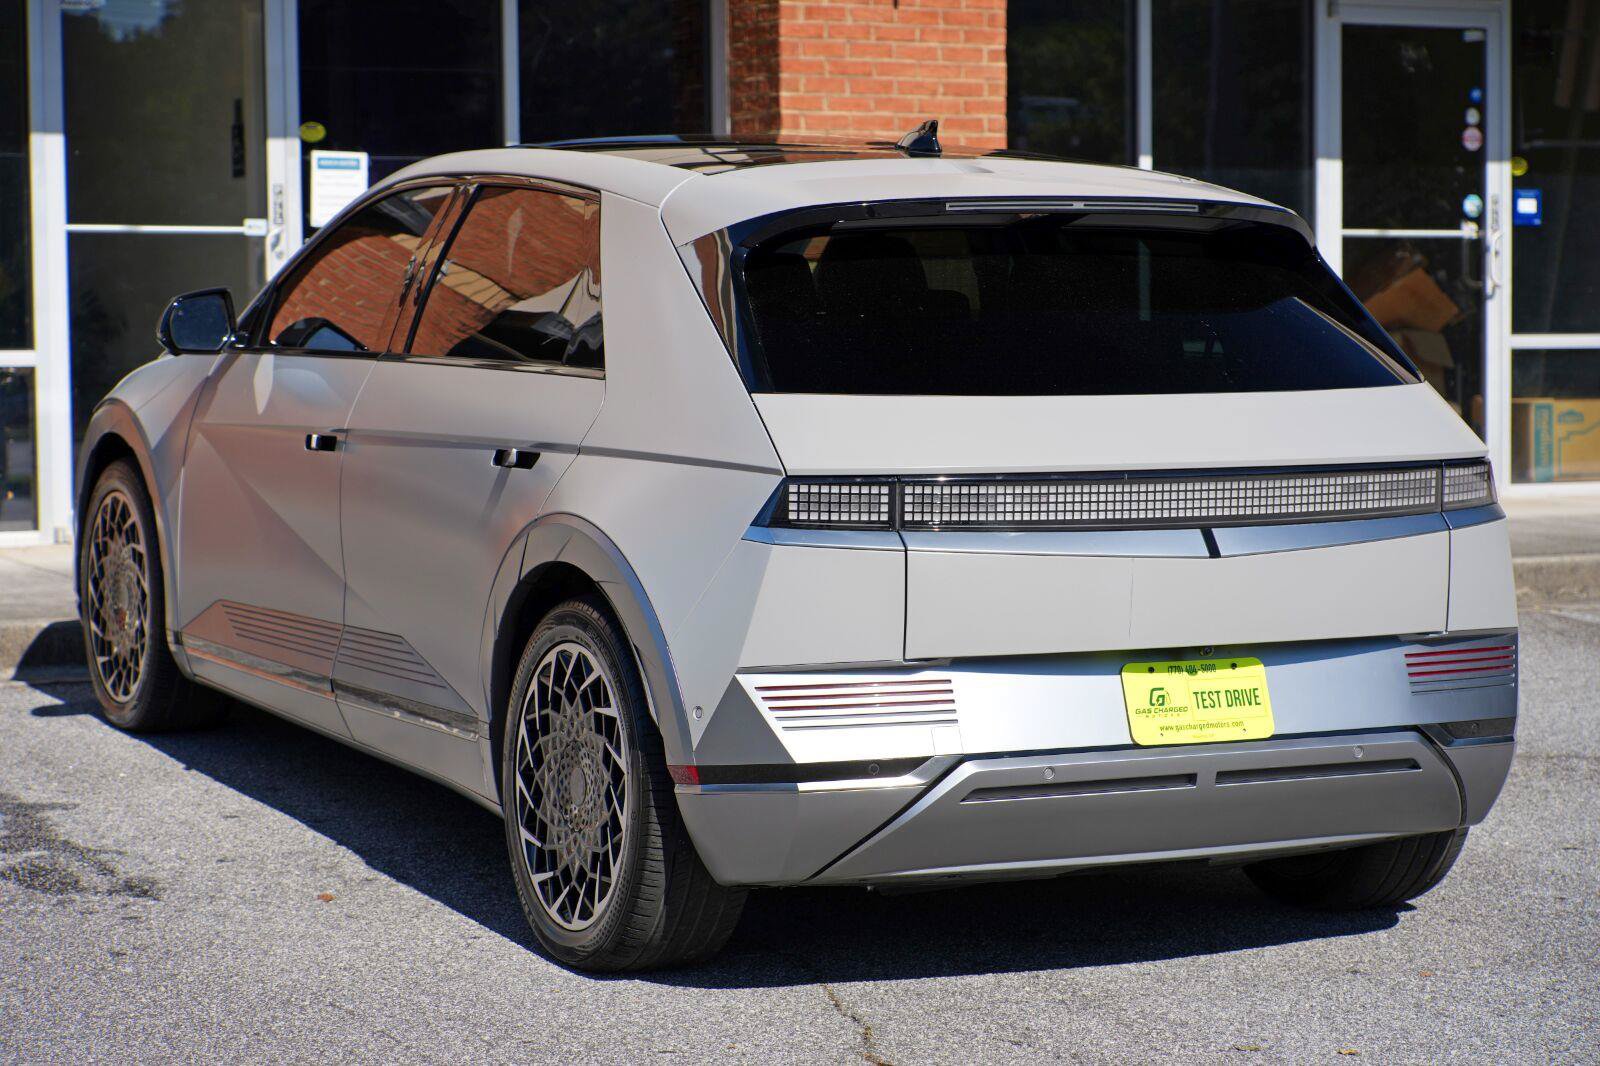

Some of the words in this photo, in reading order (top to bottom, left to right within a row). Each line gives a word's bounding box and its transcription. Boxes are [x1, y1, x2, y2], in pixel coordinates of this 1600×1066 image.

[1193, 690, 1222, 710] TEST
[1225, 687, 1262, 708] DRIVE
[1135, 707, 1152, 715] GAS
[1153, 706, 1189, 715] CHARGED
